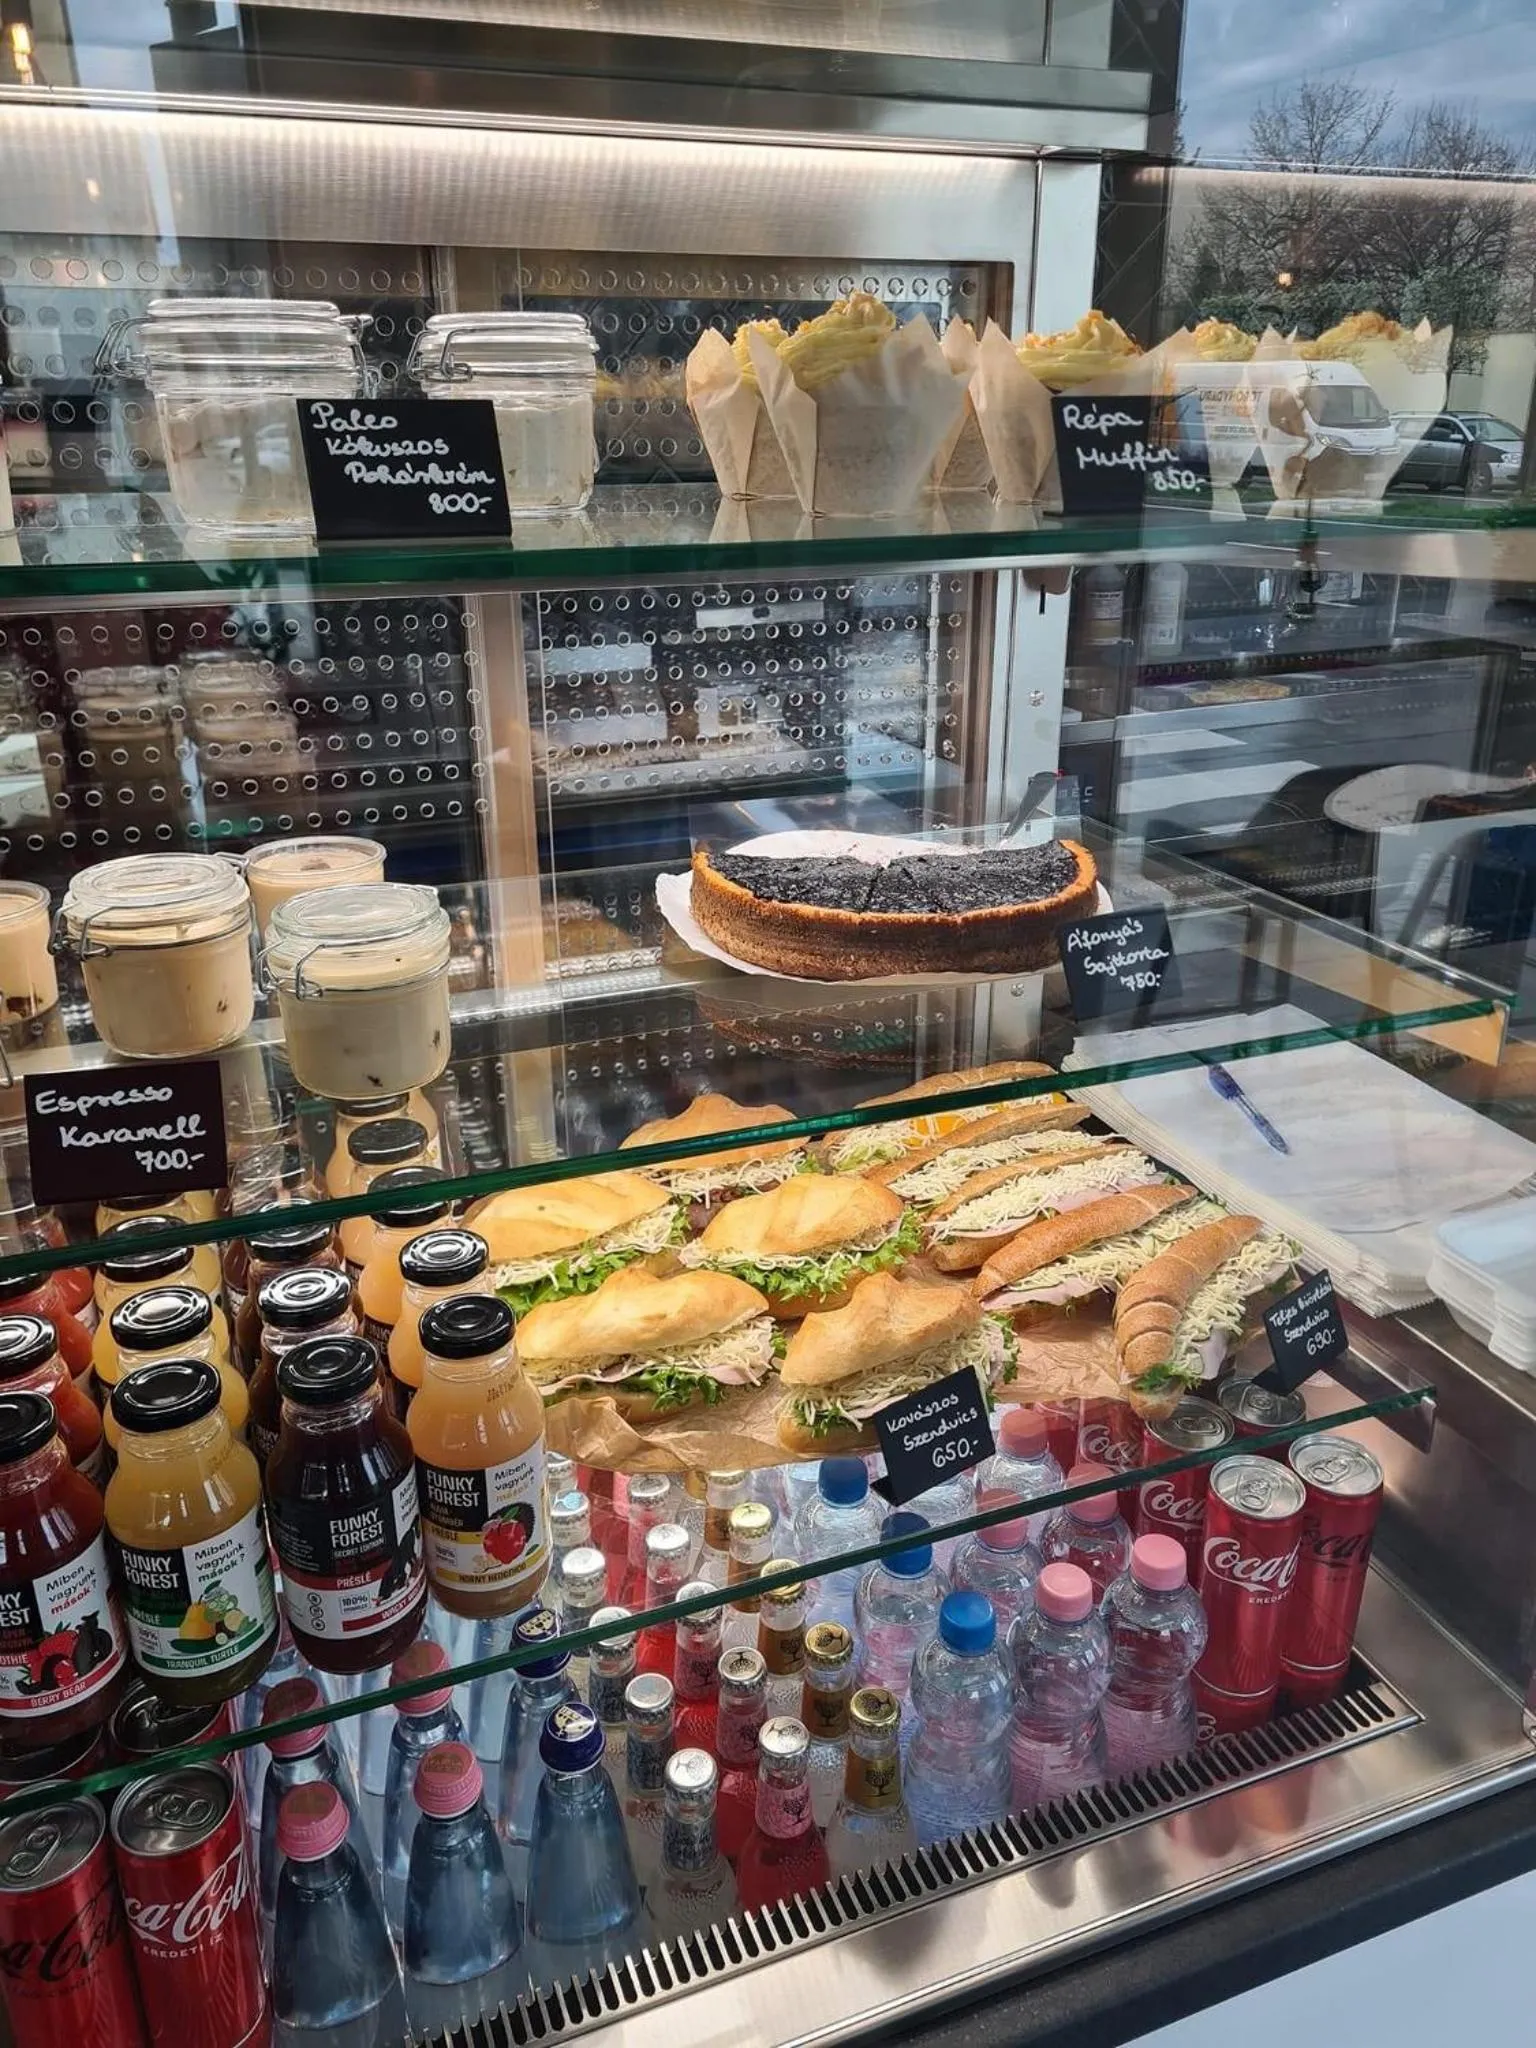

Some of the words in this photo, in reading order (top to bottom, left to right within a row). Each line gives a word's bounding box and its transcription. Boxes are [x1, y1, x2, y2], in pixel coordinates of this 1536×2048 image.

[310, 401, 398, 432] Paleo
[1062, 403, 1144, 436] Répa
[1076, 440, 1180, 471] Muffin
[35, 1086, 173, 1117] Espresso
[59, 1113, 206, 1148] Karamell
[903, 1407, 978, 1452] Szendvics
[426, 1470, 475, 1492] FUNKY
[494, 1462, 527, 1481] Miben
[495, 1466, 535, 1492] vagyunk
[427, 1485, 480, 1507] FOREST
[329, 1507, 380, 1535] FUNKY
[331, 1520, 384, 1548] FOREST
[122, 1549, 173, 1574] FUNKY
[194, 1538, 233, 1561] Miben
[196, 1543, 245, 1573] vagyunk
[45, 1565, 85, 1593] Miben
[48, 1568, 96, 1603] vagyunk
[125, 1569, 180, 1590] FOREST
[30, 1692, 60, 1708] BERRY
[63, 1681, 87, 1699] BEAR
